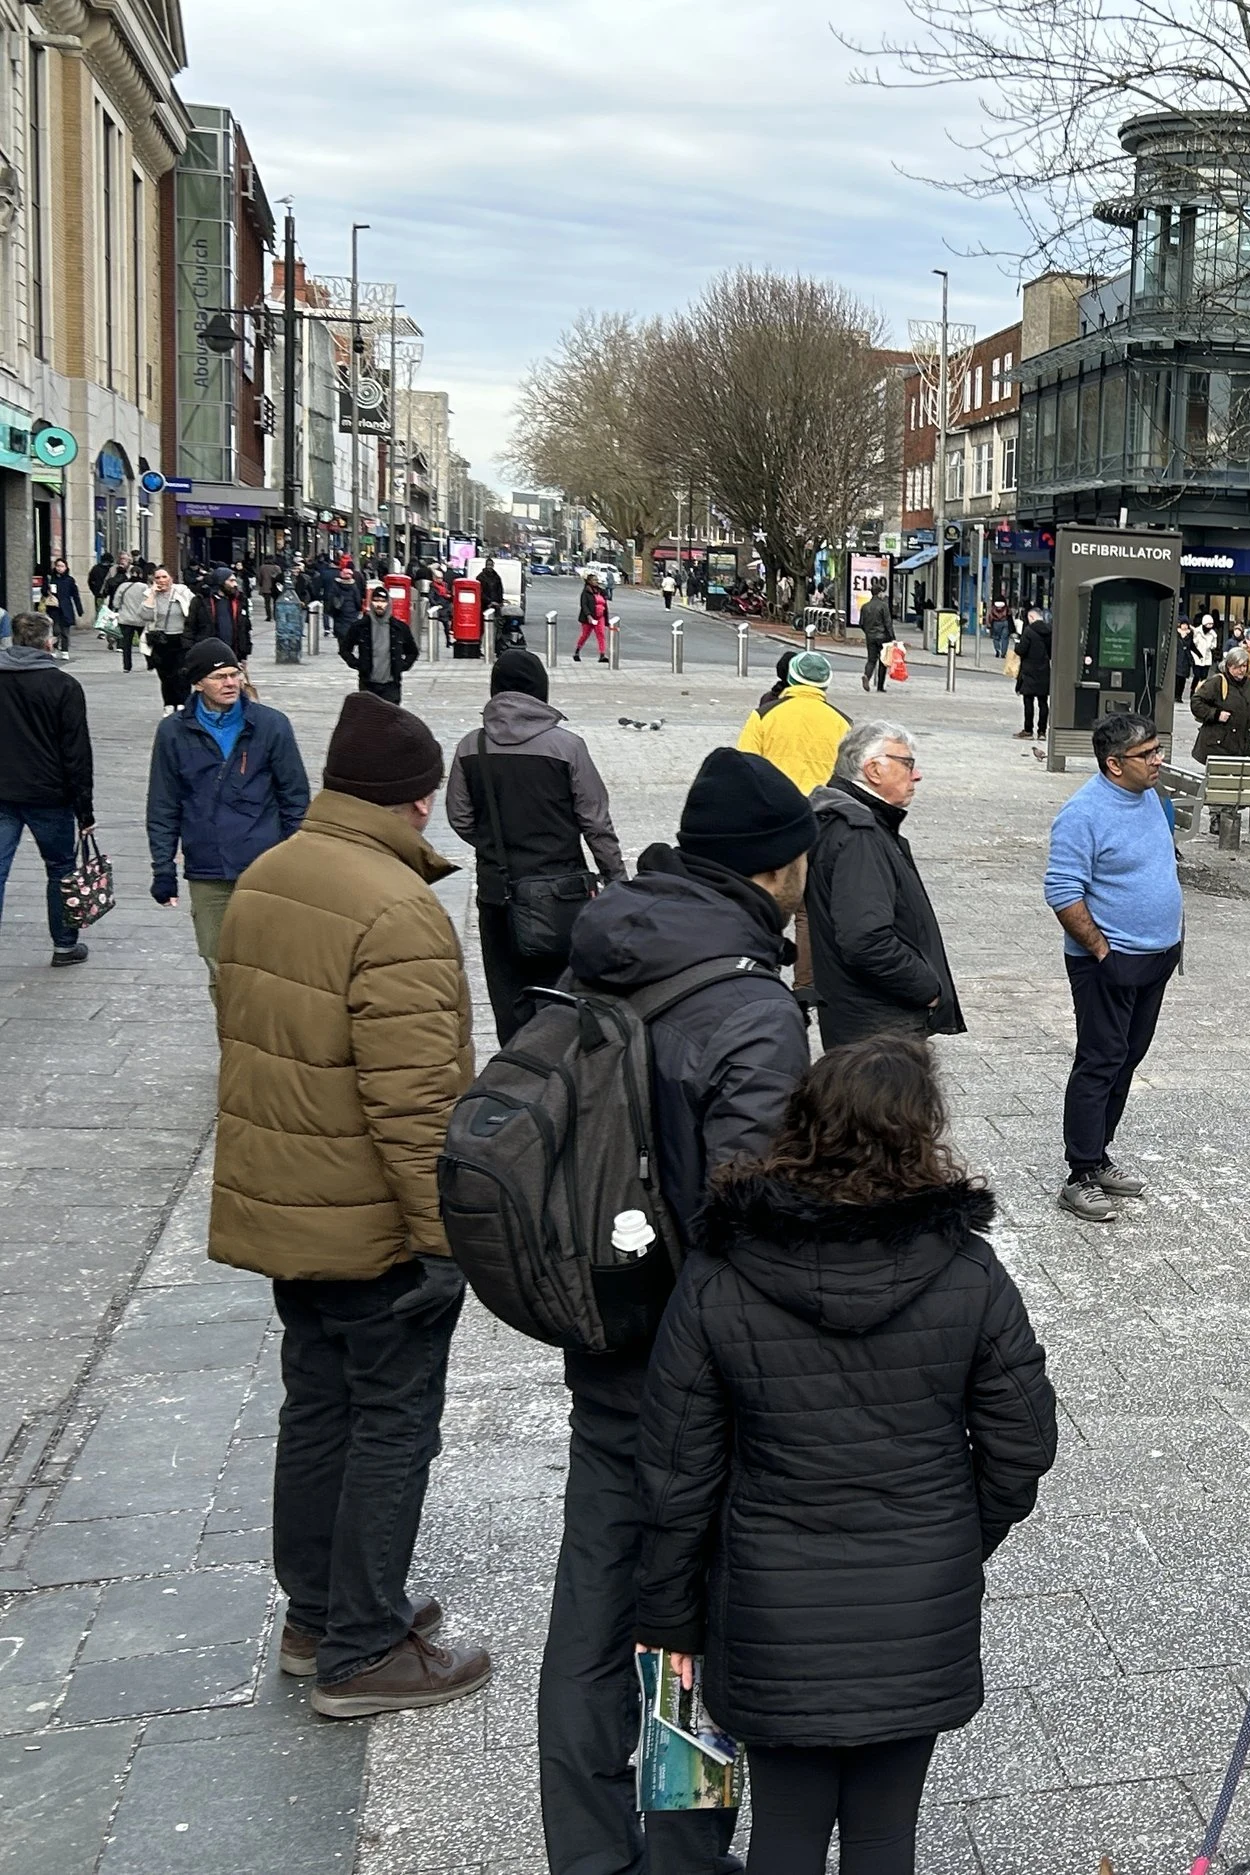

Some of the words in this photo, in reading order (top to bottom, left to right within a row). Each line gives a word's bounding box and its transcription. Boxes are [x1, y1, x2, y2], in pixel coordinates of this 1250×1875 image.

[192, 239, 209, 298] Church
[341, 418, 391, 430] mrlands
[1071, 542, 1172, 561] DEFIBRILLATOR
[1180, 554, 1234, 569] tionwide
